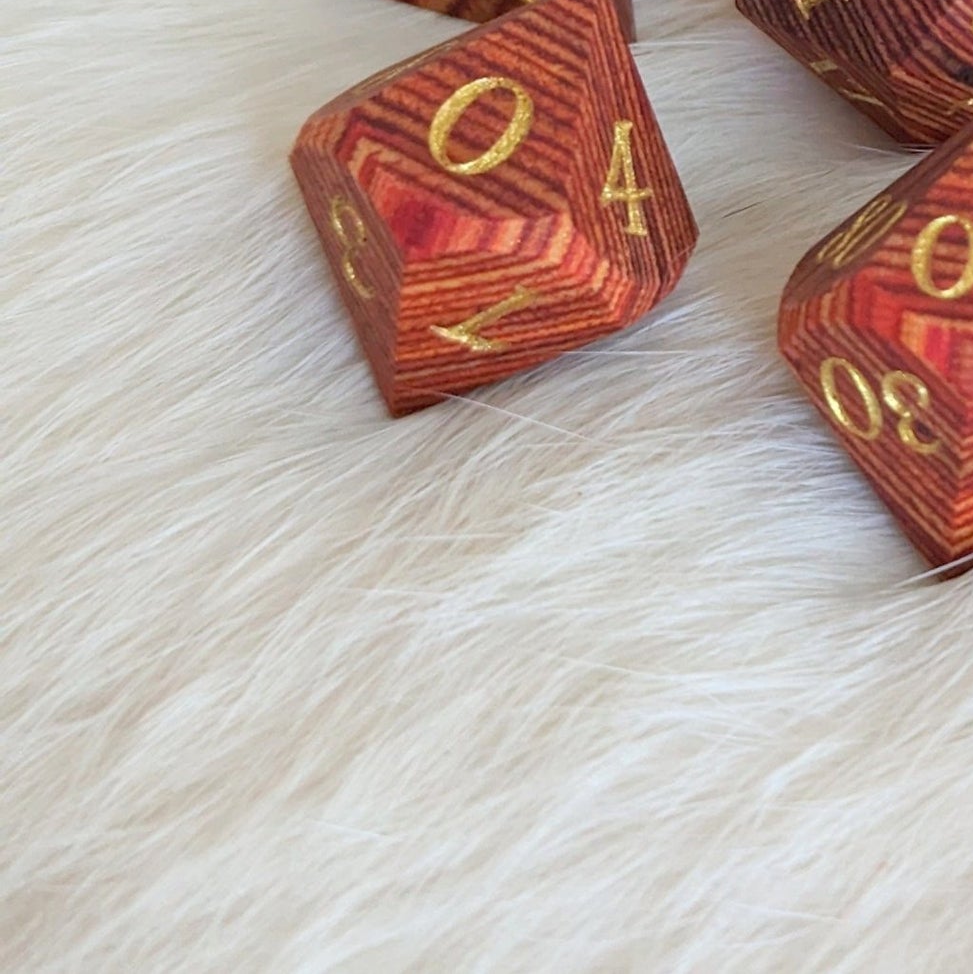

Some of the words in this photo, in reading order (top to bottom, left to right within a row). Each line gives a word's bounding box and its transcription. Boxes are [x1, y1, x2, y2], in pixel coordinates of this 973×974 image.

[428, 76, 535, 175] 0
[600, 119, 653, 237] 4
[818, 356, 944, 454] 30
